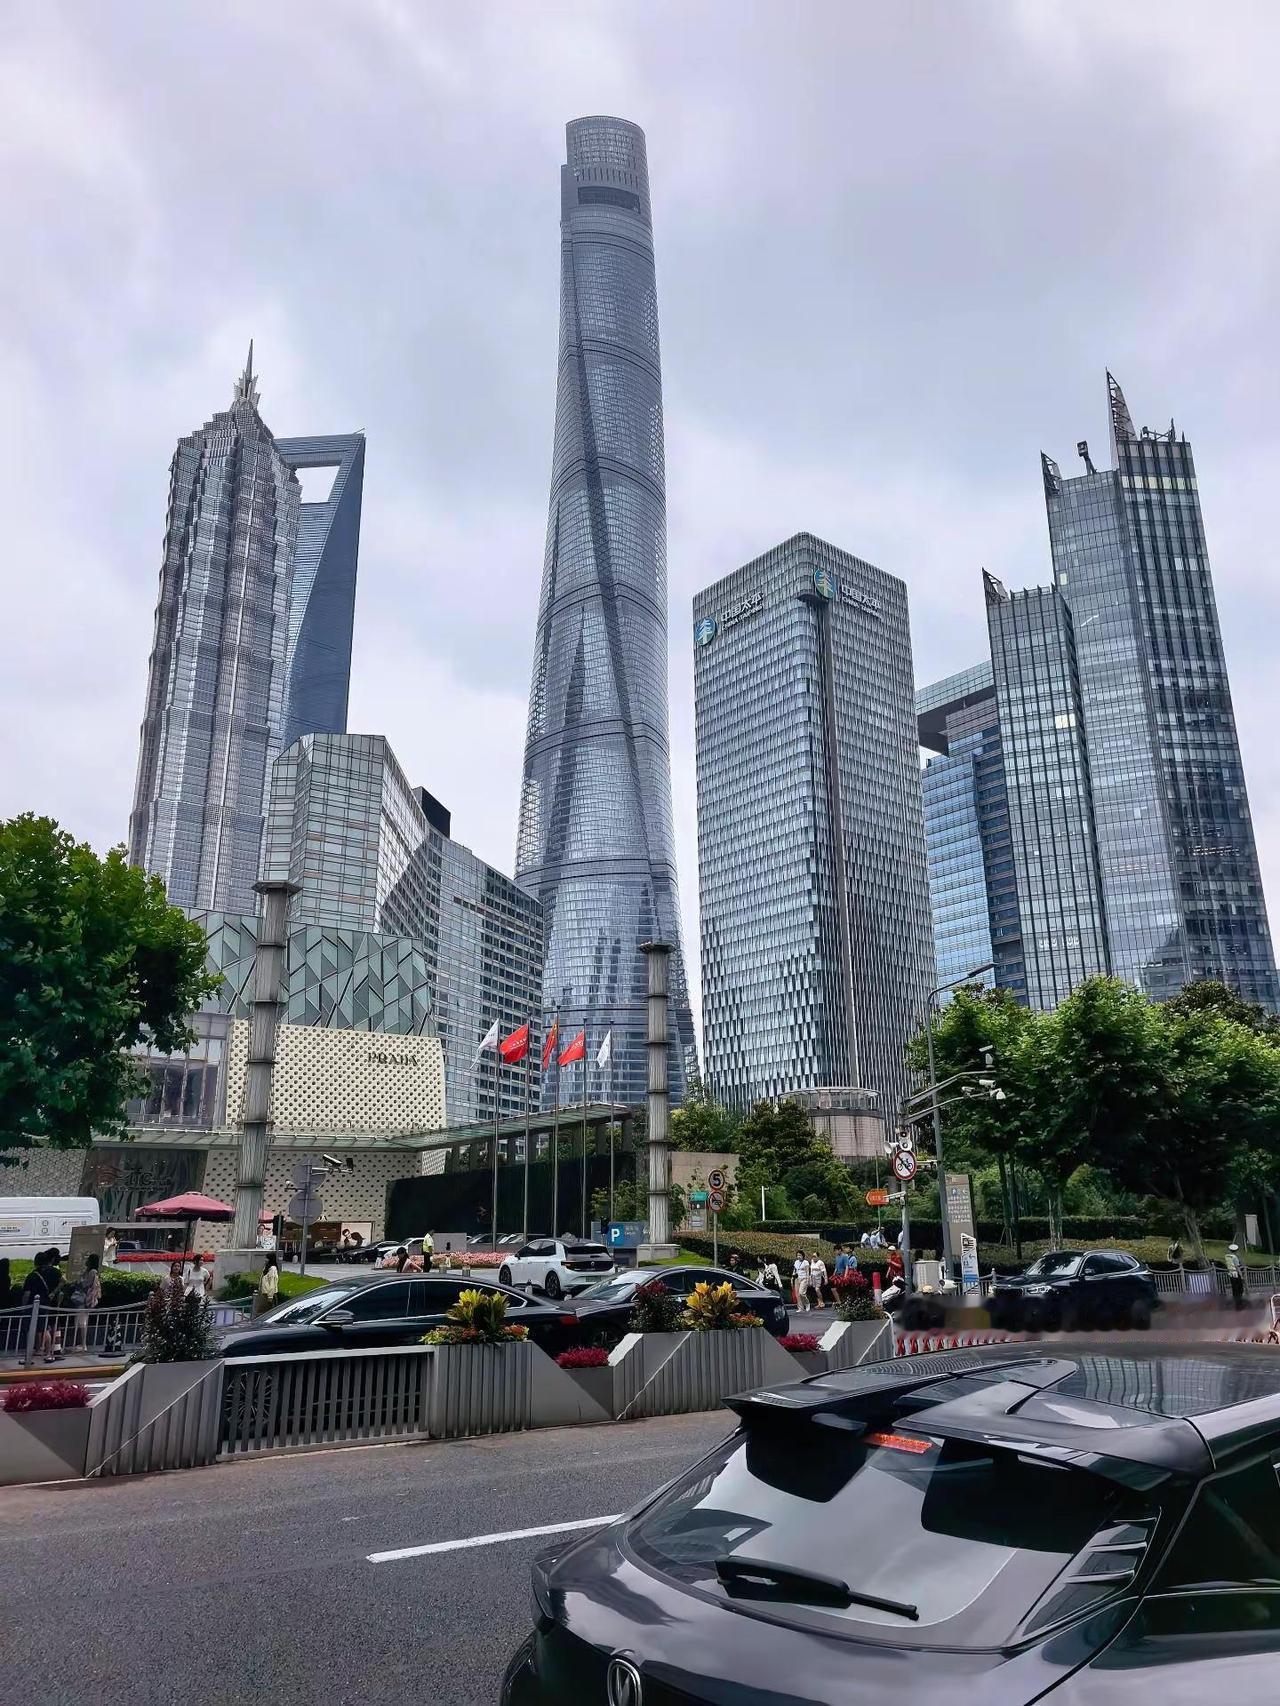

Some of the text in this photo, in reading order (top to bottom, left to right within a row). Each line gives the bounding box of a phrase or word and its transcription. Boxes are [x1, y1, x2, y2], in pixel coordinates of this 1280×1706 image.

[720, 591, 763, 622] 中国太平
[842, 584, 882, 610] 中国太平
[713, 1173, 722, 1186] 5
[611, 1228, 621, 1242] P
